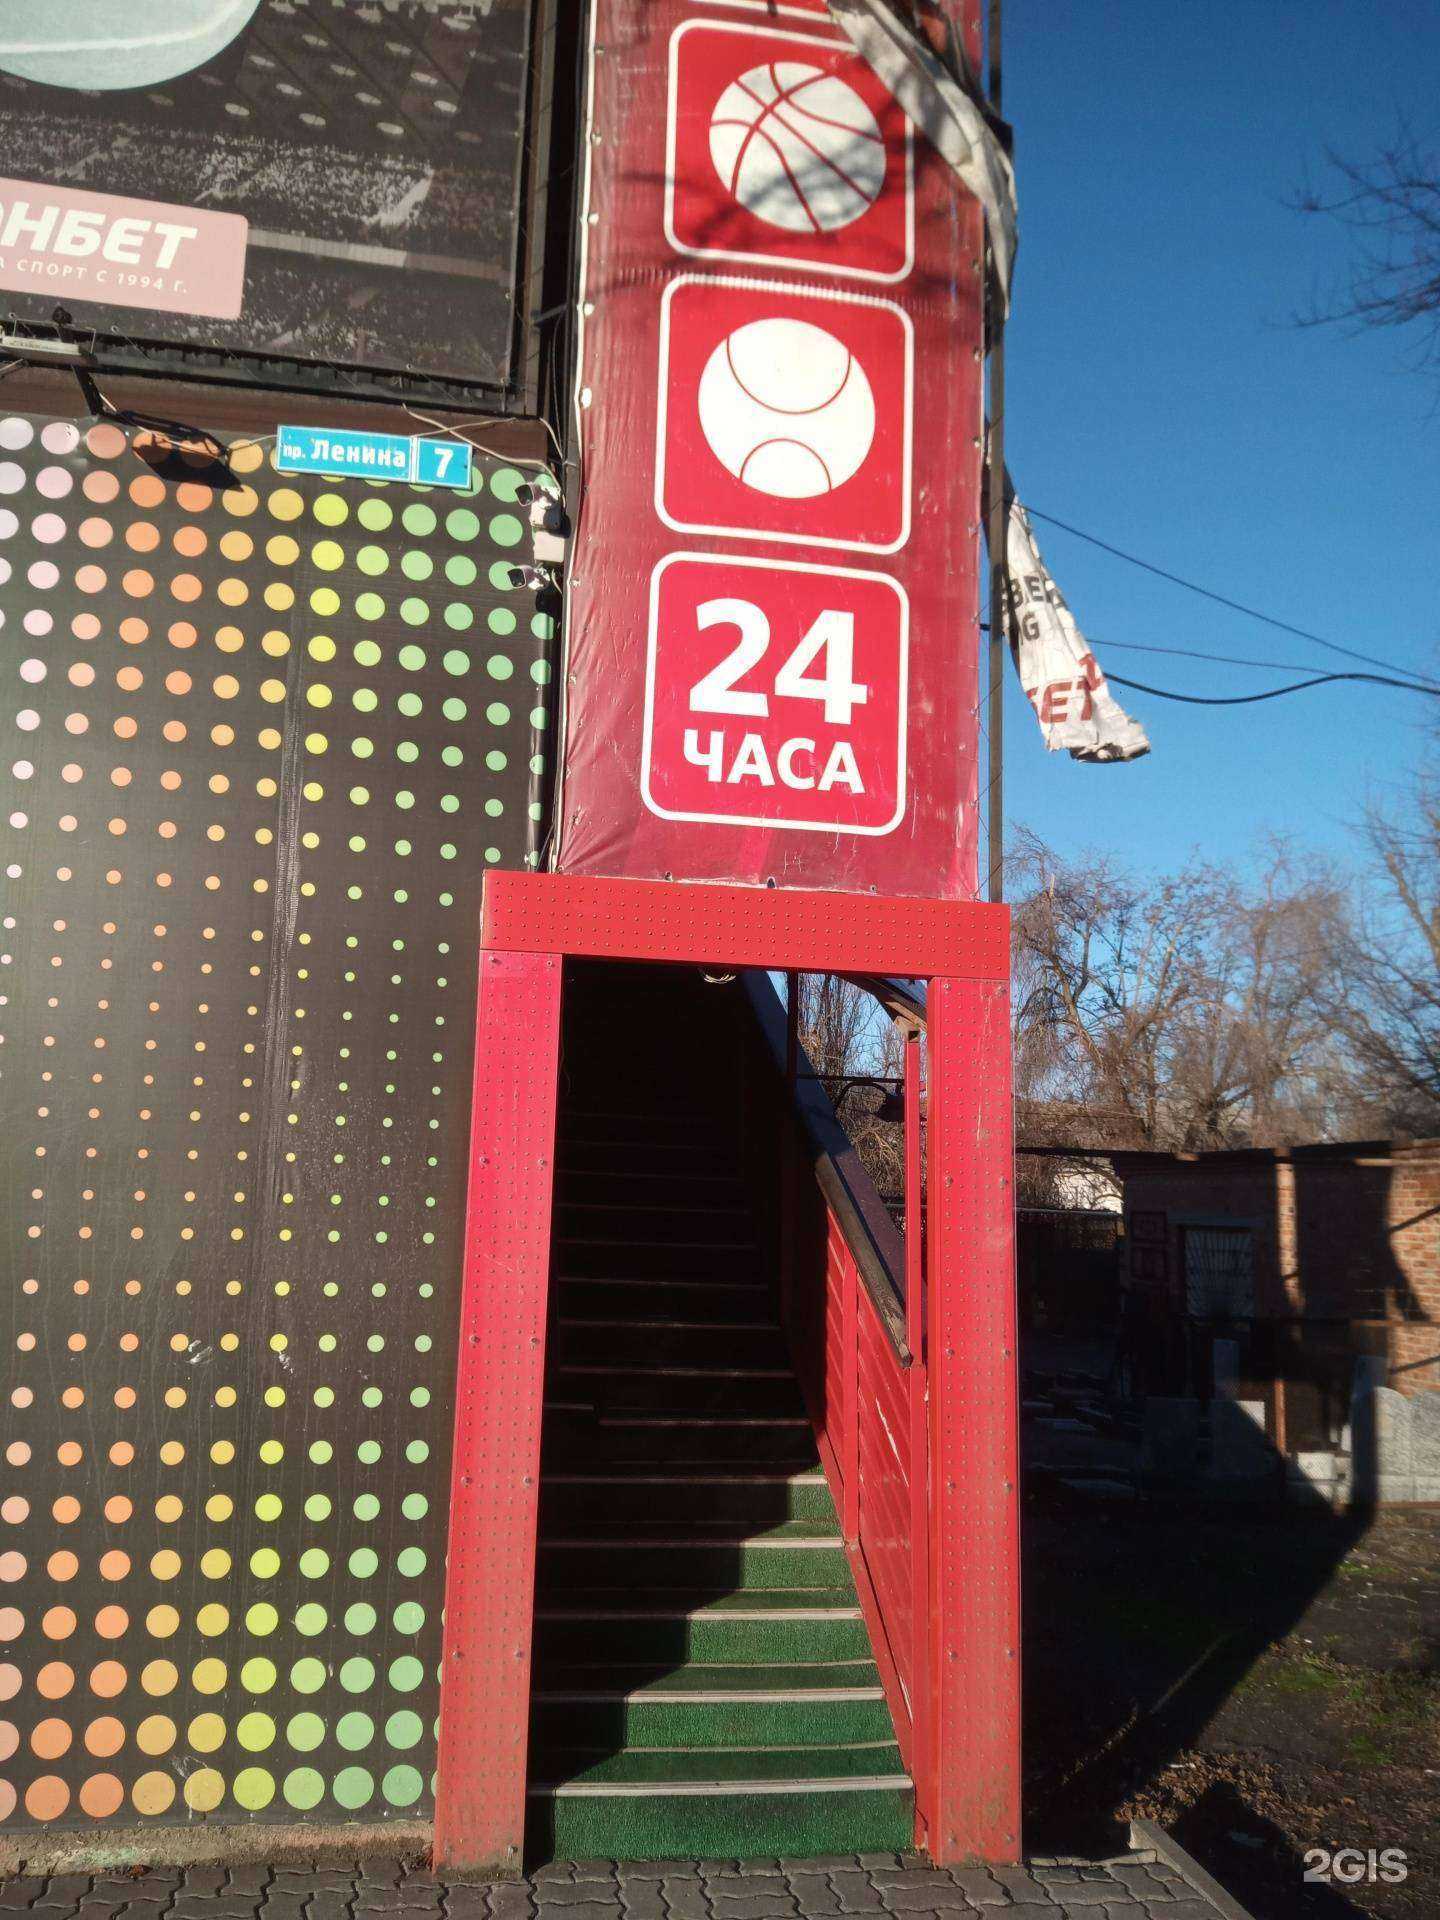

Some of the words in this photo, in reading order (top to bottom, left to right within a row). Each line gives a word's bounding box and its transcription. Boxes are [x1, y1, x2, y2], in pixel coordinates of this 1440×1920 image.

[0, 202, 197, 269] НБЕТ
[17, 259, 88, 279] СПОРТ
[118, 273, 163, 290] 1994
[283, 443, 305, 459] пр.
[311, 438, 406, 468] Ленина
[434, 447, 454, 478] 7
[689, 598, 868, 725] 24
[684, 728, 866, 794] ЧАСА
